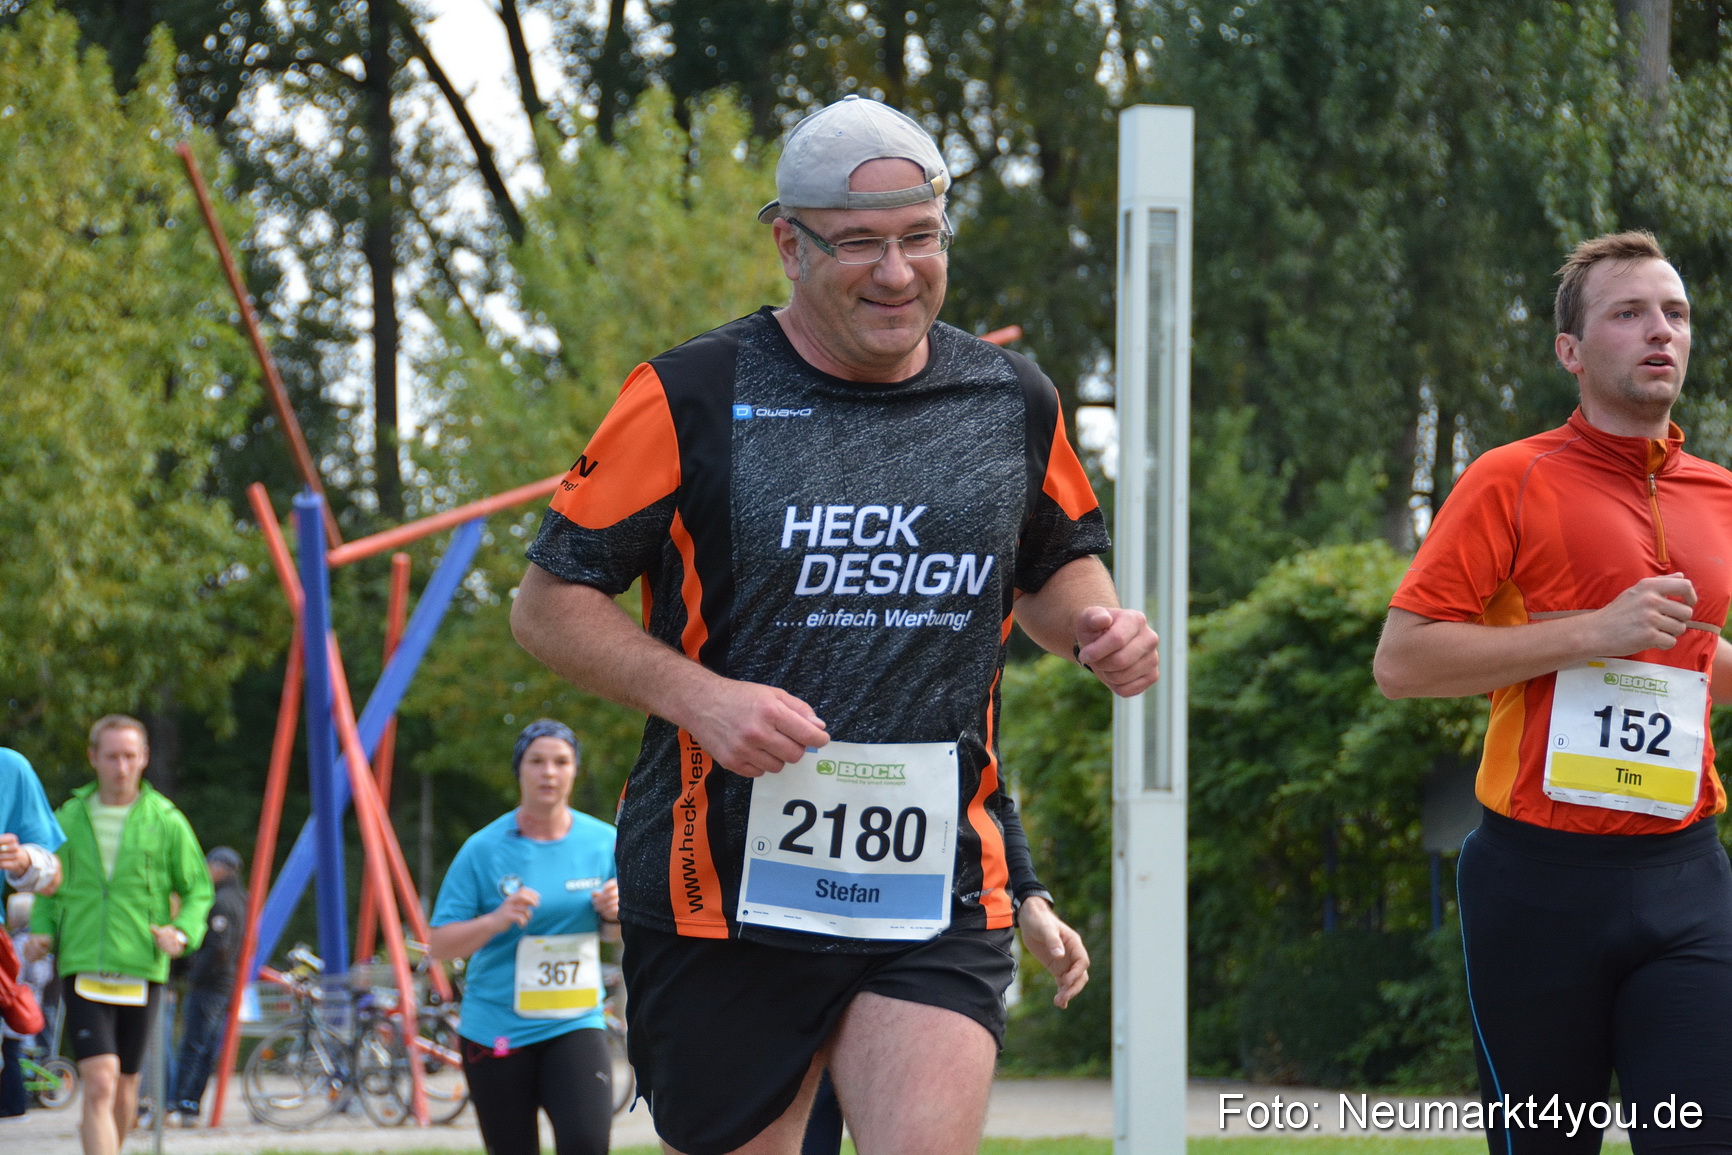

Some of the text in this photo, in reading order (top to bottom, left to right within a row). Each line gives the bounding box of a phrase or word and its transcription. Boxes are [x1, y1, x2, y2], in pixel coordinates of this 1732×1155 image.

[780, 505, 927, 549] HECK
[794, 553, 994, 595] DESIGN
[884, 608, 972, 631] Werbung!
[1620, 674, 1668, 693] BOCK
[1557, 737, 1565, 747] D
[1593, 705, 1671, 758] 152
[837, 761, 906, 780] BOCK
[1615, 767, 1642, 786] Tim
[778, 799, 927, 863] 2180
[757, 840, 765, 851] D
[815, 878, 880, 903] Stefan
[538, 961, 581, 986] 367
